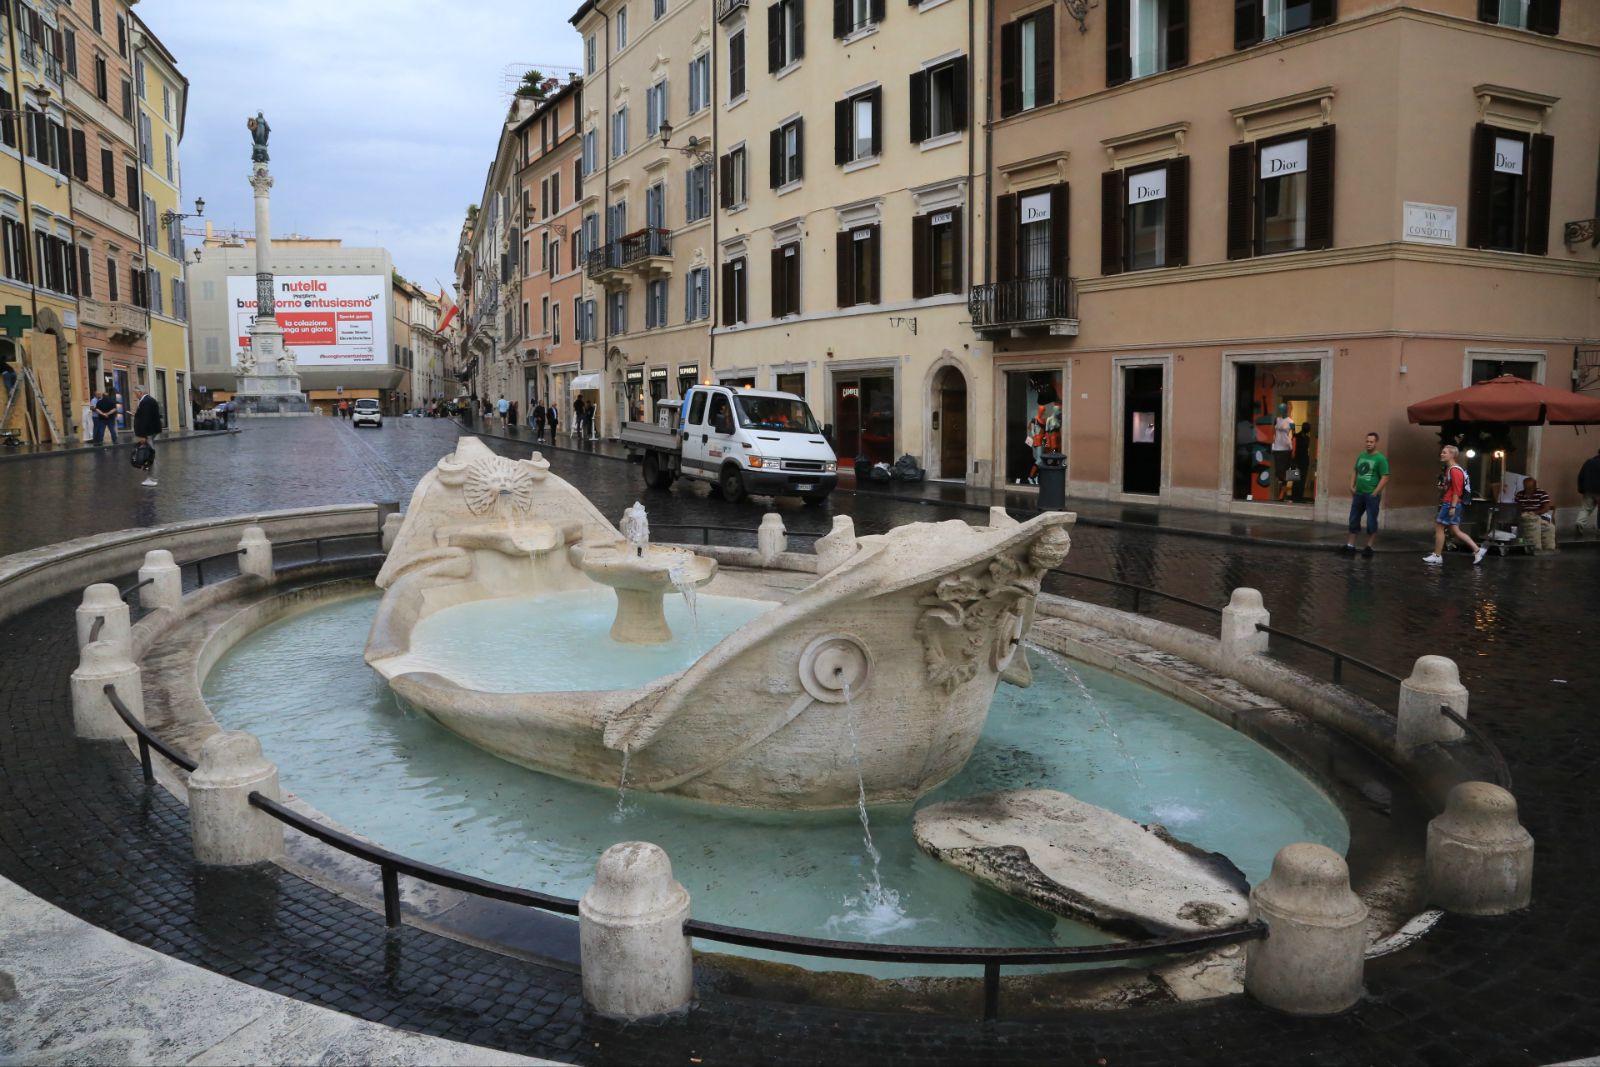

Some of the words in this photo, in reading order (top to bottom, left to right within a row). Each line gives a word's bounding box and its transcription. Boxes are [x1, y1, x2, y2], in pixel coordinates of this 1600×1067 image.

[1270, 158, 1298, 173] Dior
[1496, 152, 1516, 169] Dior
[1137, 186, 1161, 199] Dior
[1028, 207, 1047, 219] Dior
[1424, 211, 1437, 221] VIA
[282, 280, 327, 292] nutella
[304, 298, 372, 308] entusiasmo
[680, 367, 697, 375] SEPHORA
